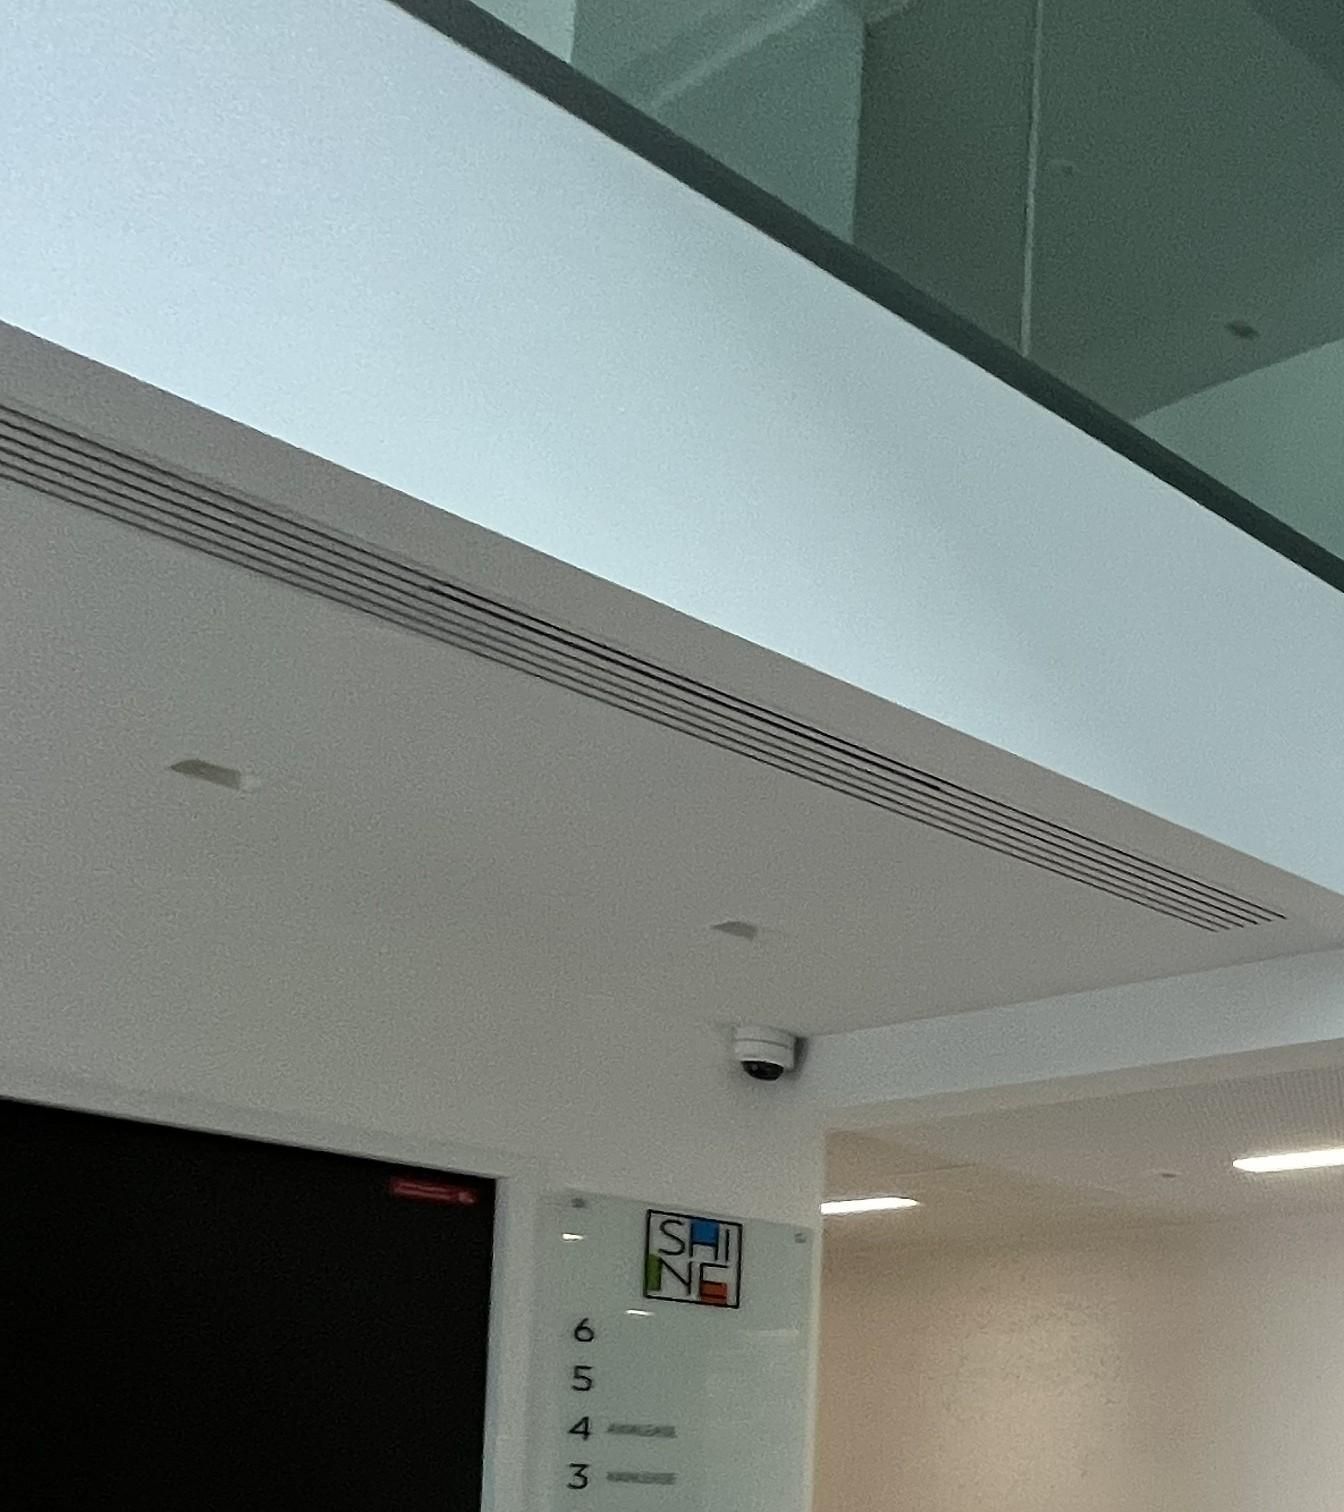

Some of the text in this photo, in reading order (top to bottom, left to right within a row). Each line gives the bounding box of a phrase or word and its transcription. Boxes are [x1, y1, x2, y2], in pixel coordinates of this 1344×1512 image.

[574, 1318, 595, 1342] 6
[572, 1365, 593, 1391] 5
[568, 1416, 591, 1441] 4
[567, 1463, 589, 1490] 3
